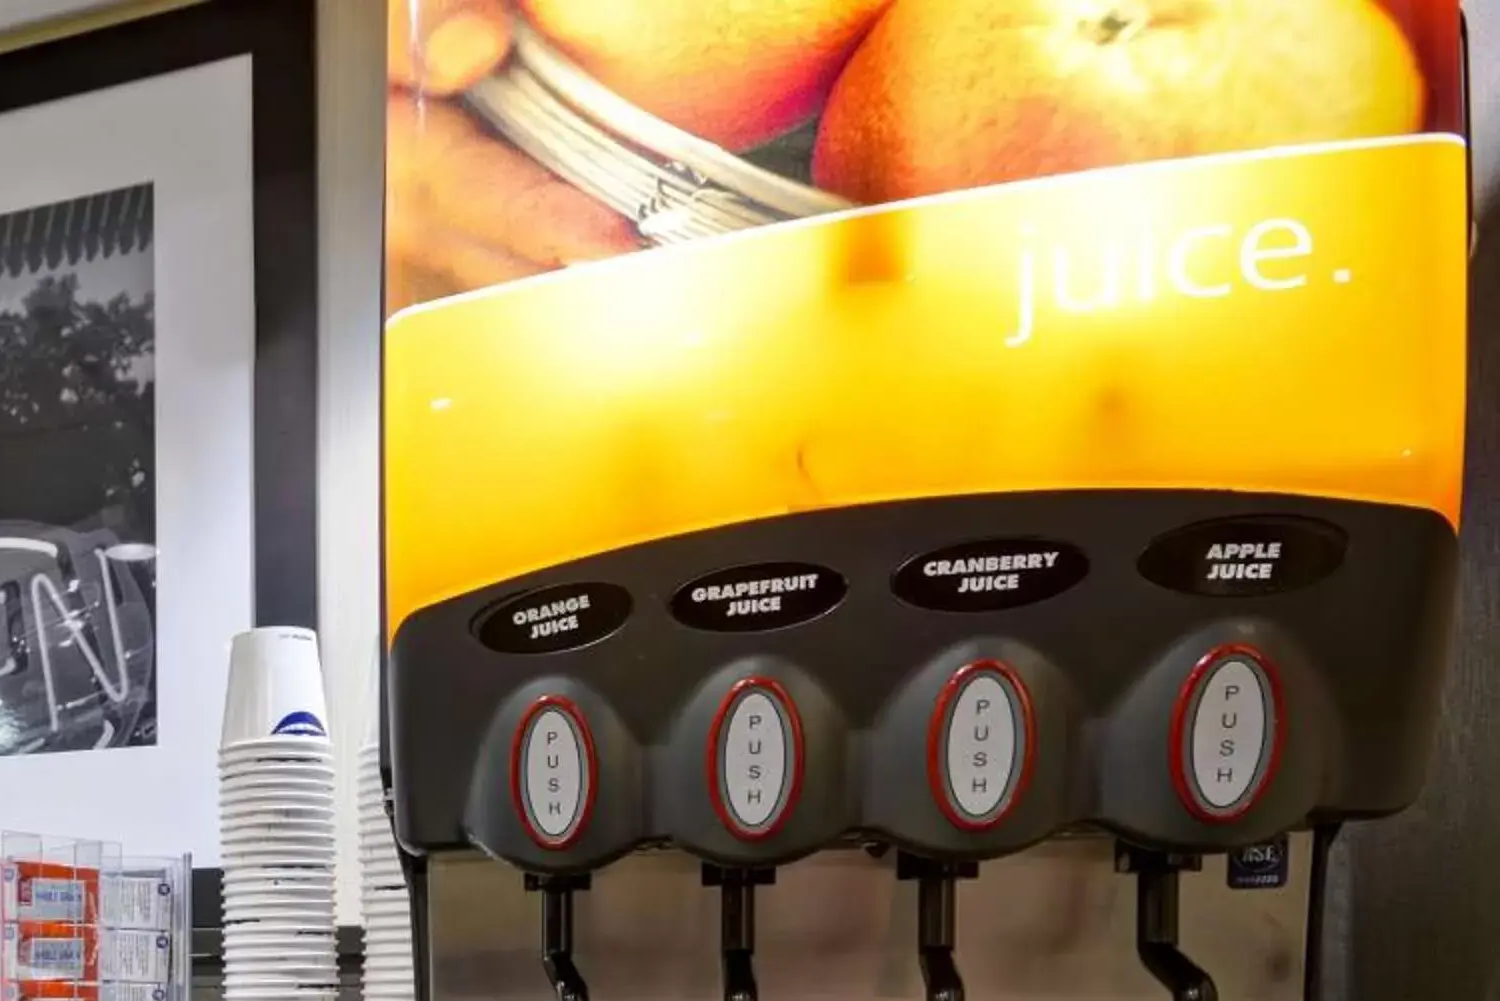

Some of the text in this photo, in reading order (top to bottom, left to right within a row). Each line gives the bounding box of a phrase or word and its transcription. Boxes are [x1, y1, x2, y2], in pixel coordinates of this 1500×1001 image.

[1004, 217, 1351, 349] juice.
[923, 551, 1060, 577] CRANBERRY
[1206, 542, 1282, 560] APPLE
[957, 574, 1020, 594] JUICE
[1207, 563, 1273, 580] JUICE
[691, 573, 819, 602] GRAPEFRUIT
[512, 594, 591, 626] ORANGE
[726, 596, 782, 617] JUICE
[530, 616, 579, 639] JUICE
[971, 699, 991, 794] PUSH
[1216, 685, 1240, 783] PUSH
[546, 731, 562, 815] PUSH
[747, 715, 762, 804] PUSH
